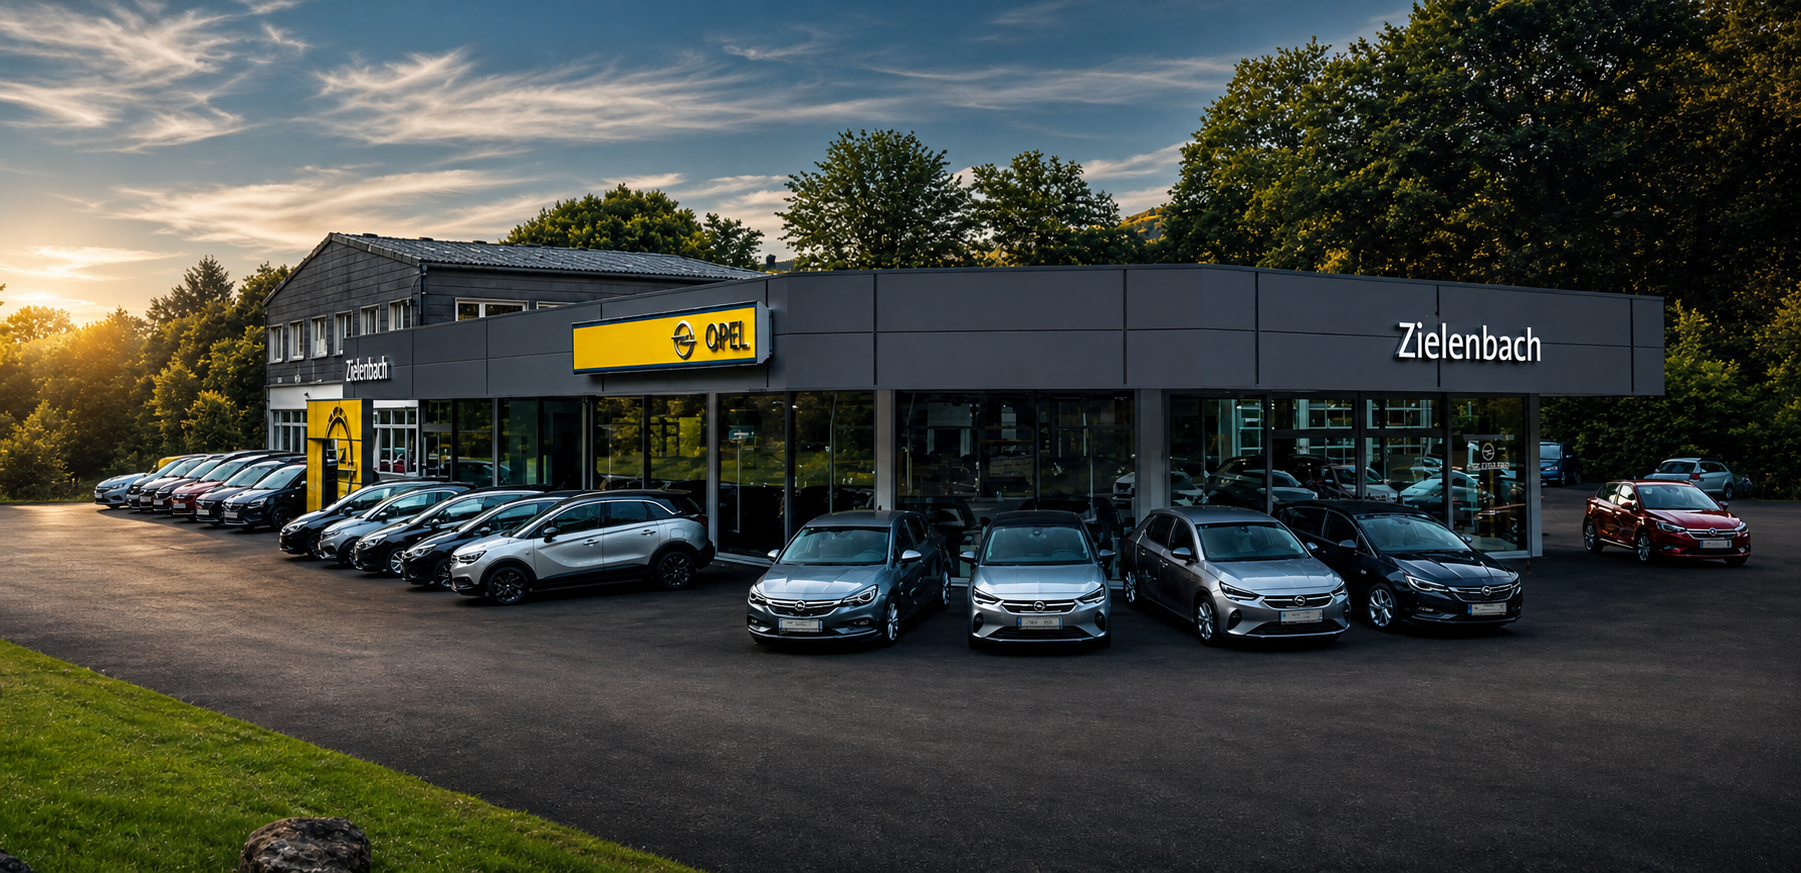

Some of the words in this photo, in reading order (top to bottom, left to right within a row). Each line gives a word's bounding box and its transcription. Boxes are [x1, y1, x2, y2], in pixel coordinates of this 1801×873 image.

[705, 320, 750, 351] OPEL
[1398, 321, 1542, 362] Zielenbach
[345, 355, 388, 382] Zielenbach
